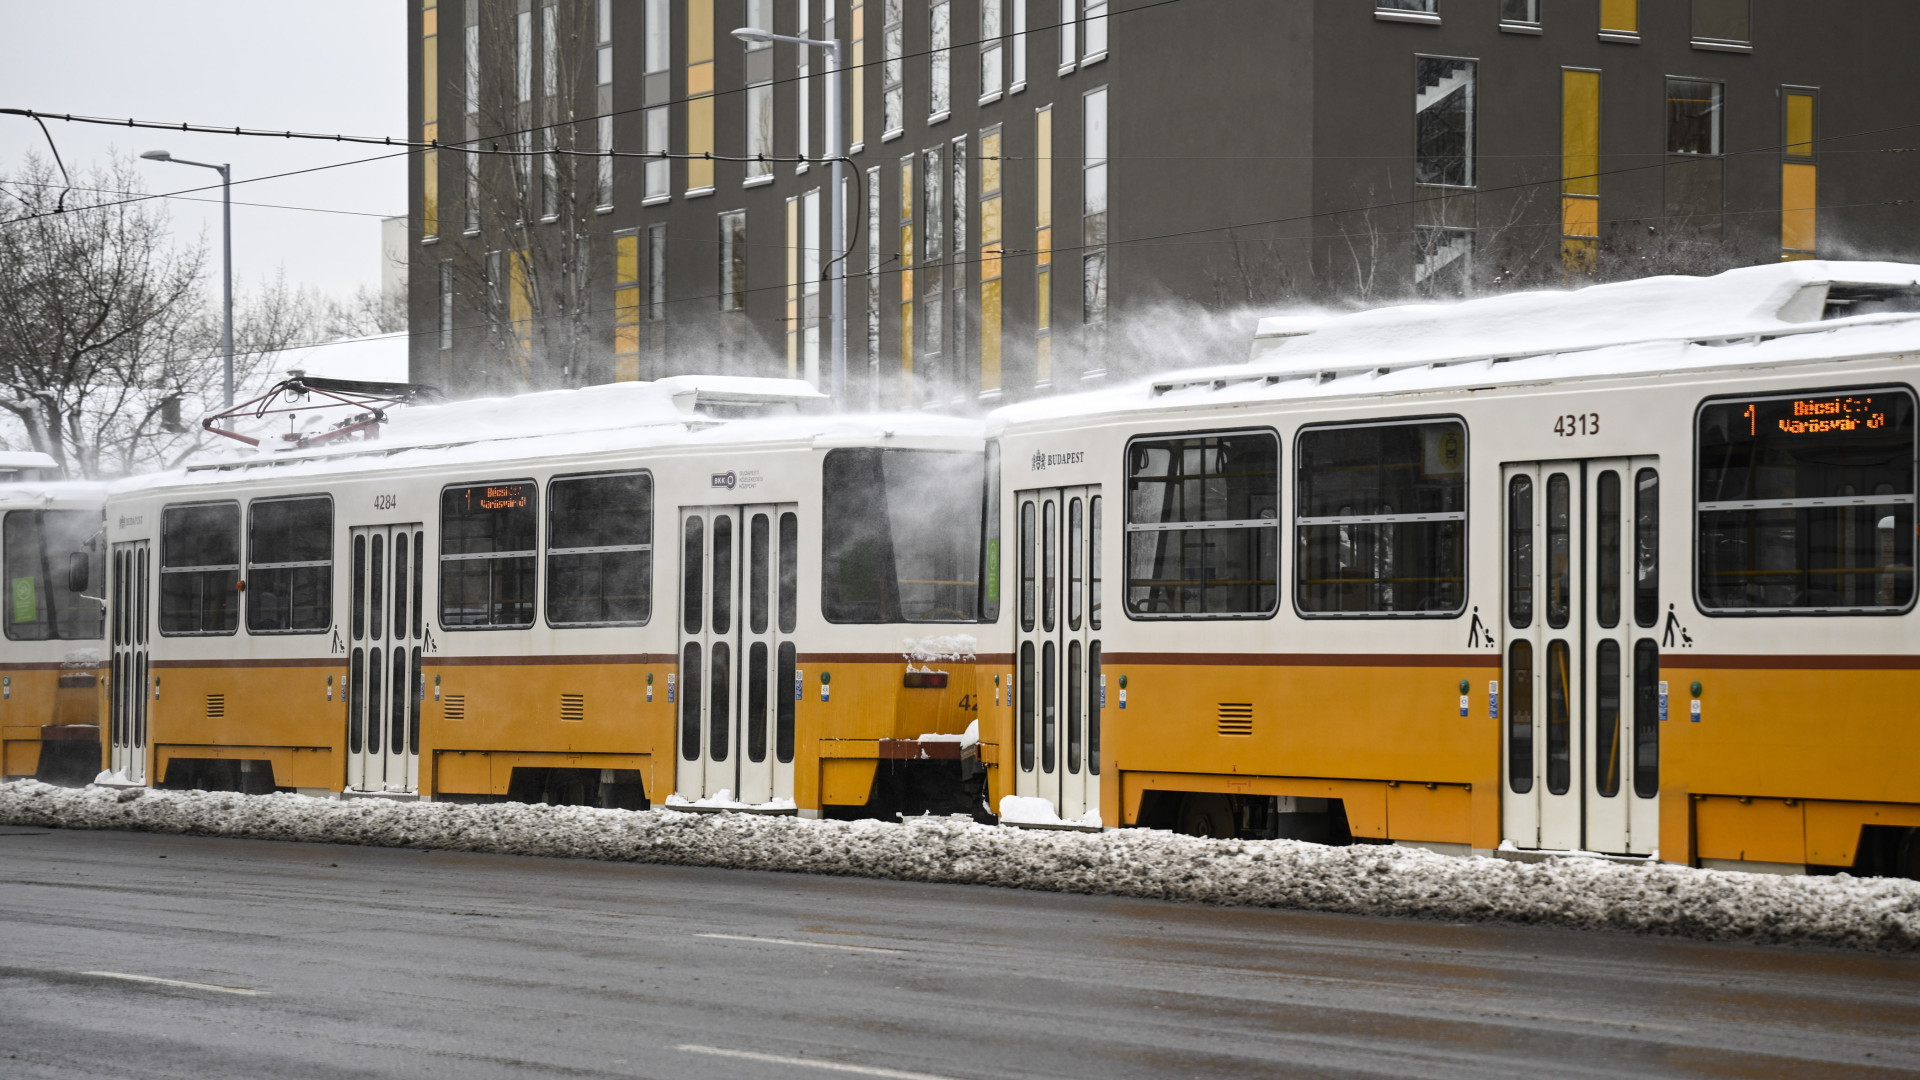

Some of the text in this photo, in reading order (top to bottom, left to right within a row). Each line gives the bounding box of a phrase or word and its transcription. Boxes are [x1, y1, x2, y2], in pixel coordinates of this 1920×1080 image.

[1554, 412, 1600, 437] 4313
[1743, 404, 1755, 436] 1
[1047, 451, 1085, 466] BUDAPEST
[374, 494, 397, 510] 4284
